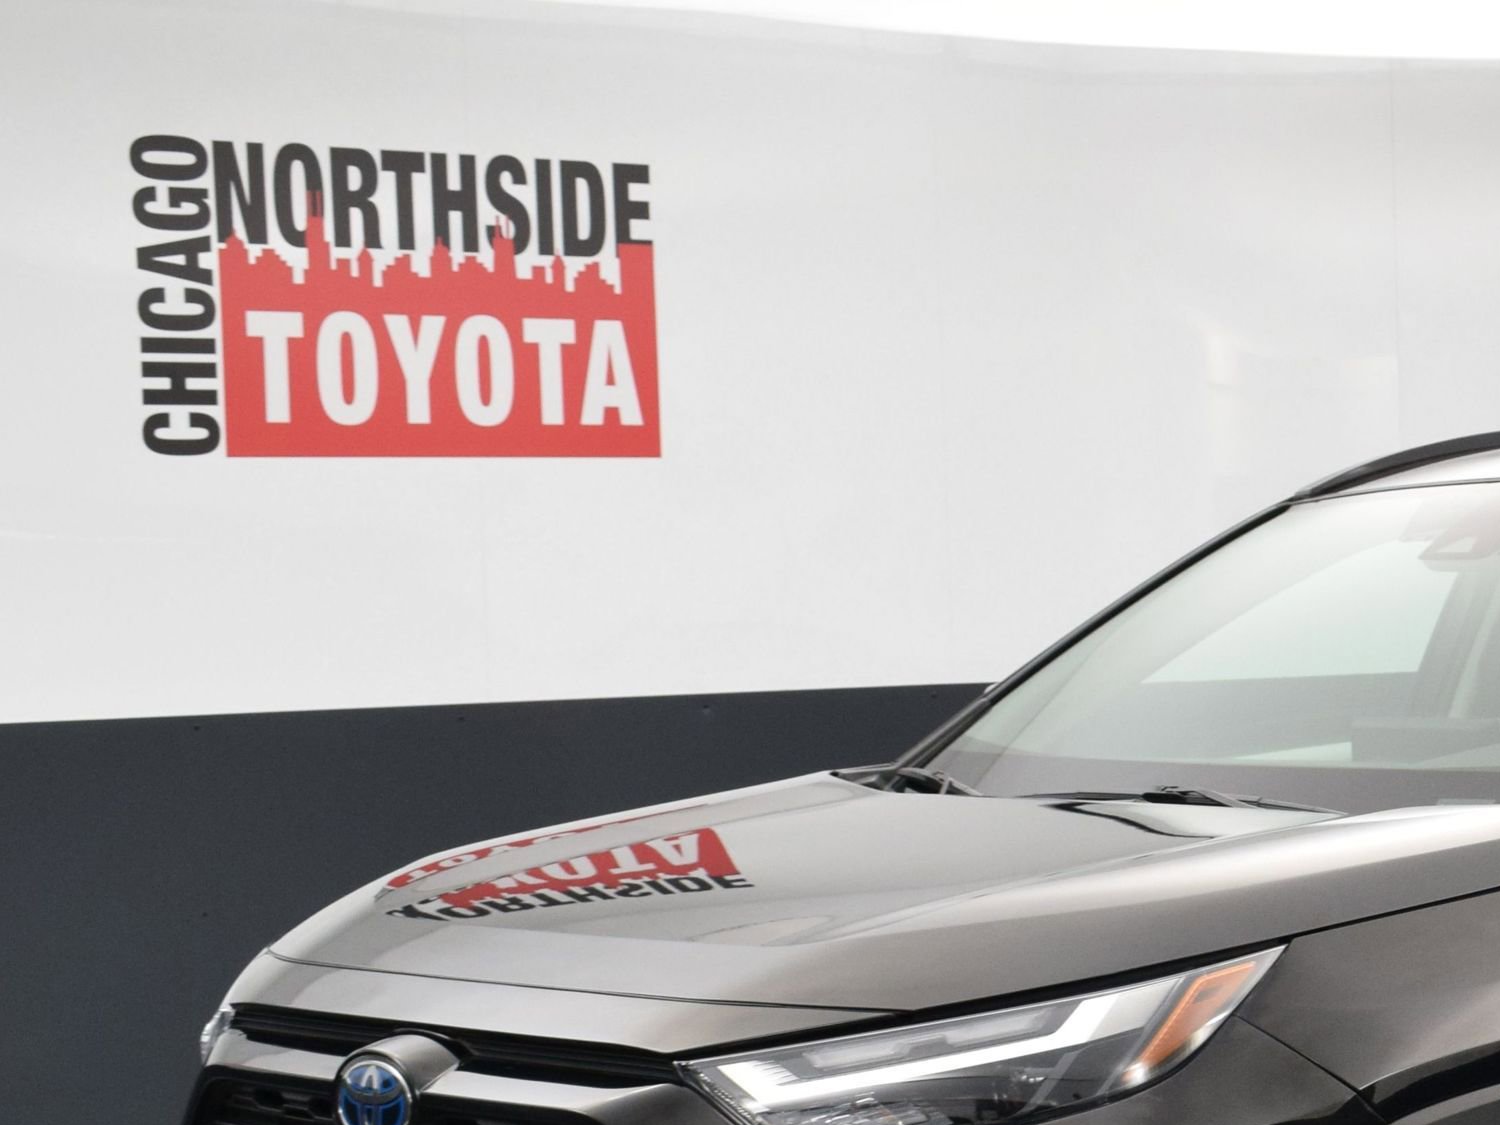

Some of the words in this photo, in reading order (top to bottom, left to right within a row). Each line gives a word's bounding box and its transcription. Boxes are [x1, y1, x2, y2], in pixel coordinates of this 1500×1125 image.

[212, 139, 653, 257] NORTHSIDE
[129, 134, 221, 457] CHICAGO
[245, 310, 645, 427] TOYOTA
